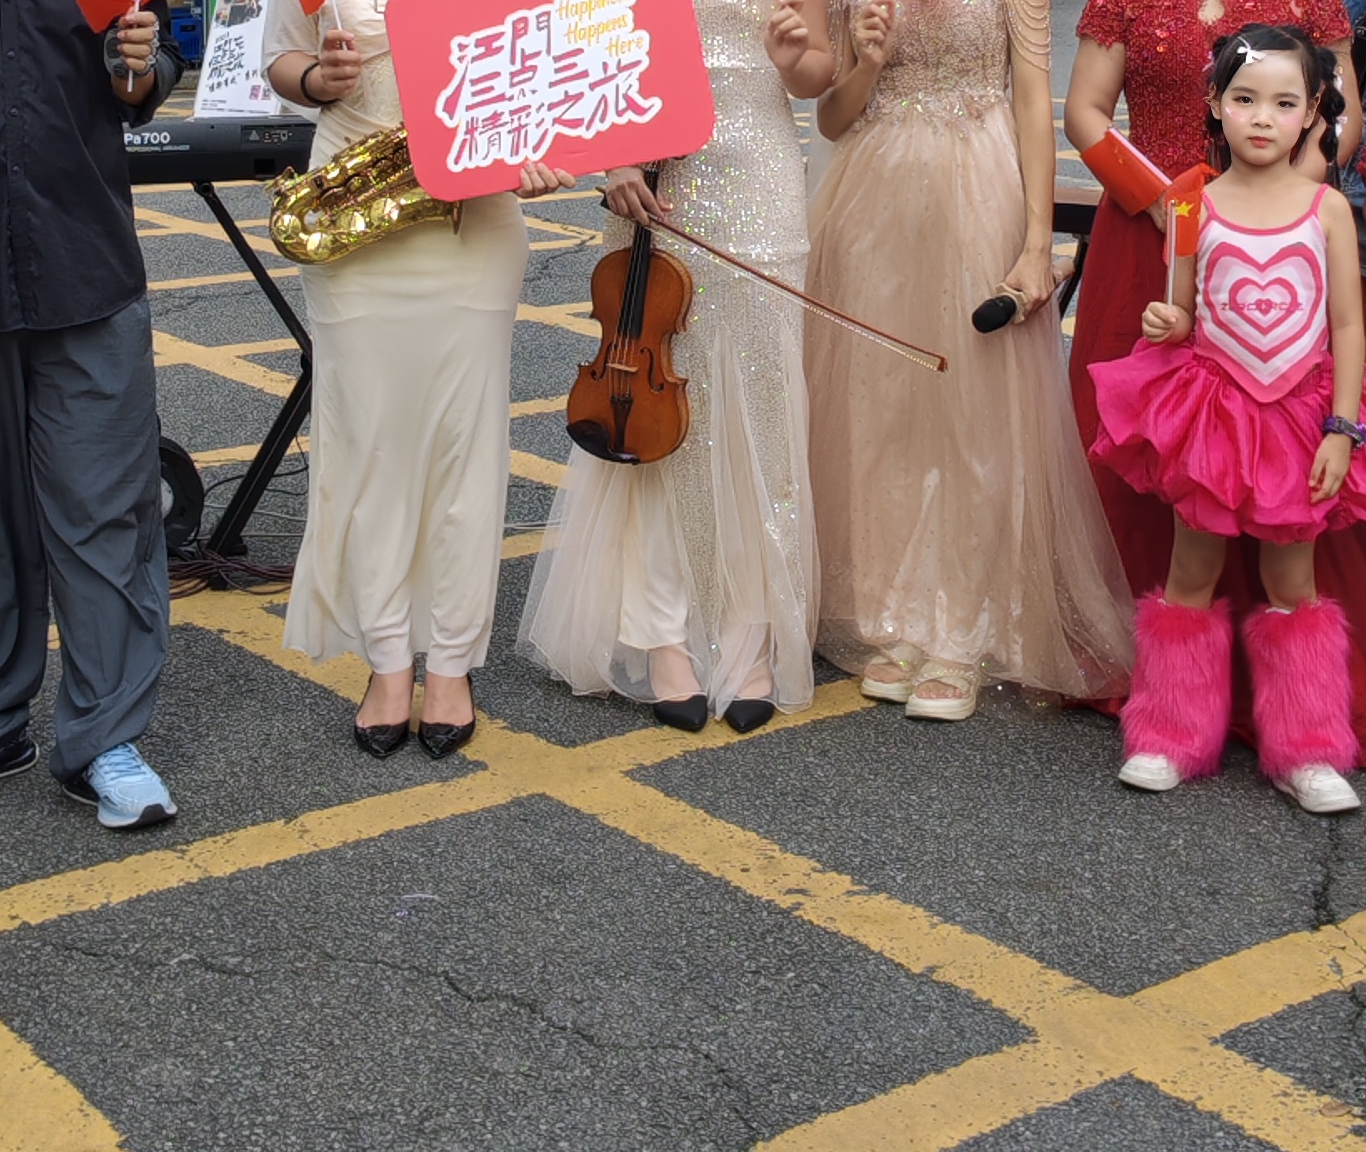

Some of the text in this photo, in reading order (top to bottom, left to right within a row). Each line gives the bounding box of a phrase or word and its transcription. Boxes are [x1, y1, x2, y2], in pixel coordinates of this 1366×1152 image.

[563, 12, 629, 46] Happens
[604, 36, 645, 58] Here
[464, 47, 590, 111] 三点三
[454, 58, 657, 165] 精彩之旅
[123, 131, 171, 145] Pa700
